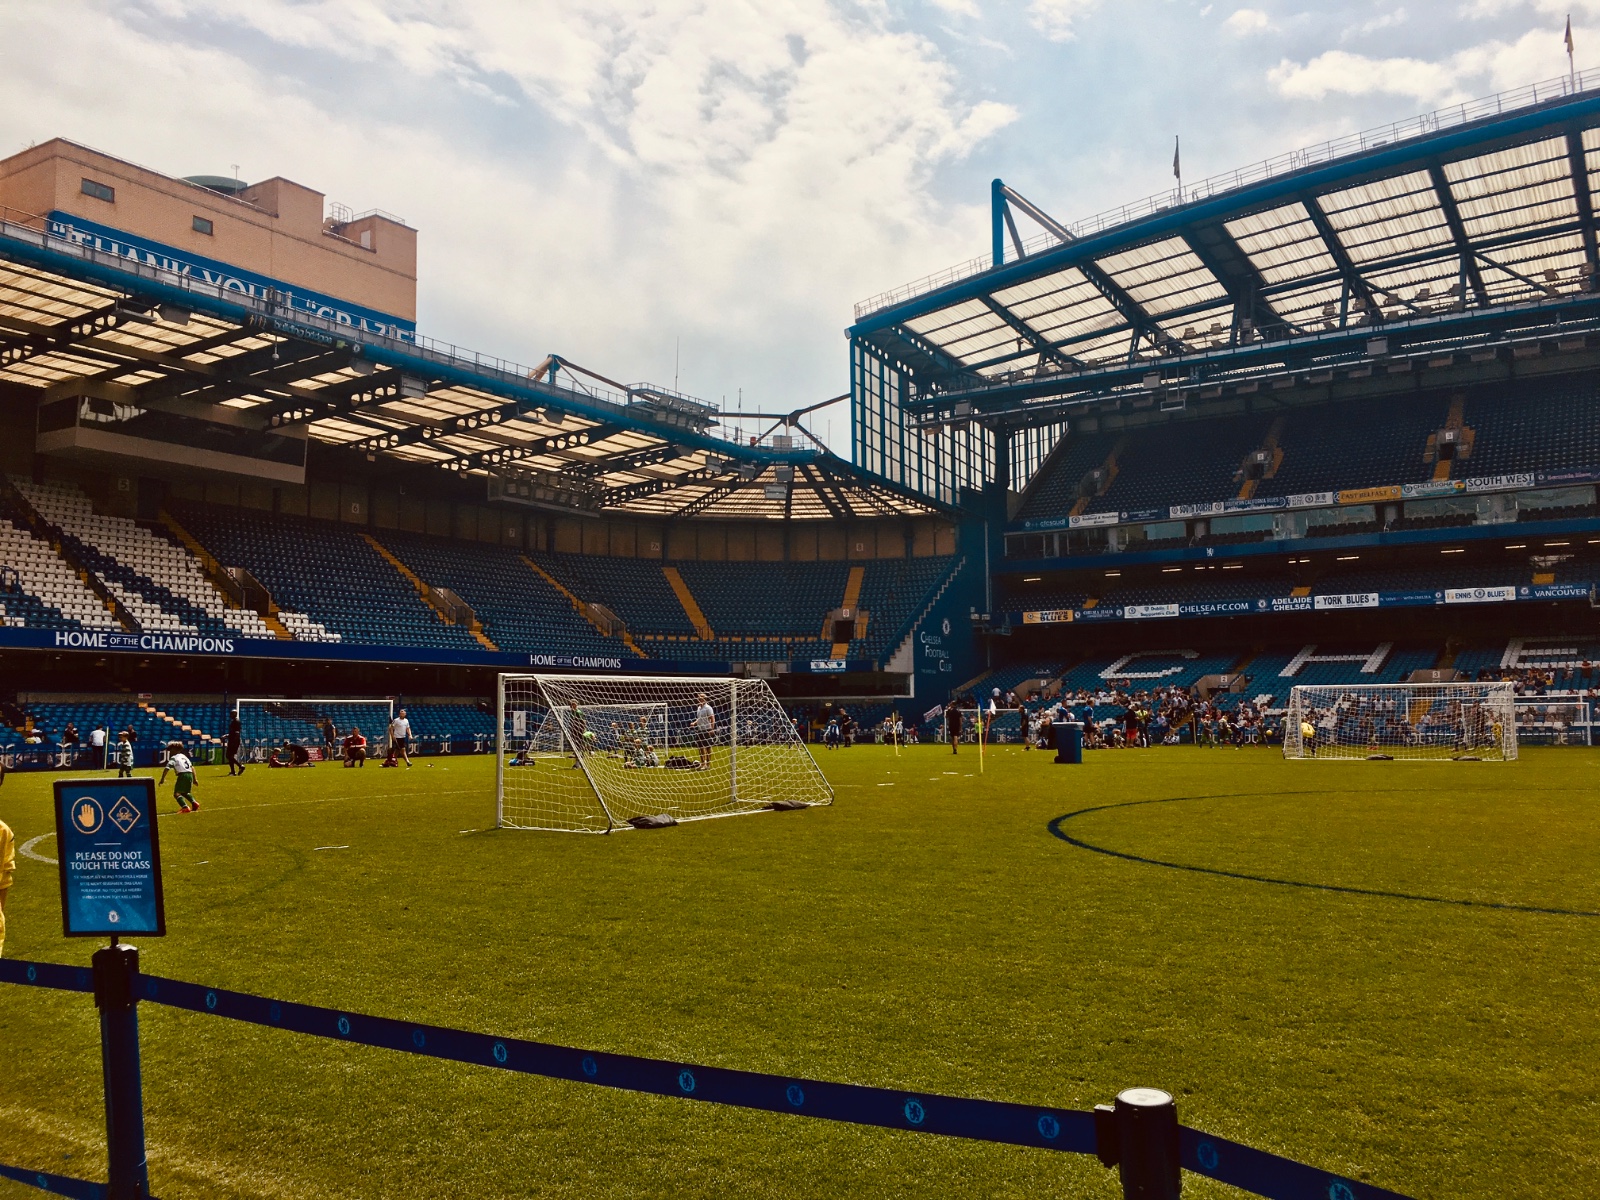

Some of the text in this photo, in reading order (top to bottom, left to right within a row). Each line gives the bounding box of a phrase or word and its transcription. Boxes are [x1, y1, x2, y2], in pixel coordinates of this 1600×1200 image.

[1468, 476, 1501, 487] SOUTH
[1506, 473, 1534, 484] WEST
[1487, 590, 1506, 598] BLUES
[1535, 589, 1587, 598] VANCOUVER
[1271, 596, 1313, 605] ADELAIDE
[1323, 596, 1343, 605] YORK
[1346, 595, 1369, 604] BLUES
[1273, 603, 1311, 611] CHELSEA
[1040, 614, 1068, 622] BLUES
[55, 631, 235, 653] HOME OF THE CHAMPIONS
[530, 654, 557, 666] HOME
[573, 656, 622, 669] CHAMPIONS
[75, 851, 142, 861] PLEASE DO NOT
[70, 861, 151, 870] TOUCH THE GRASS
